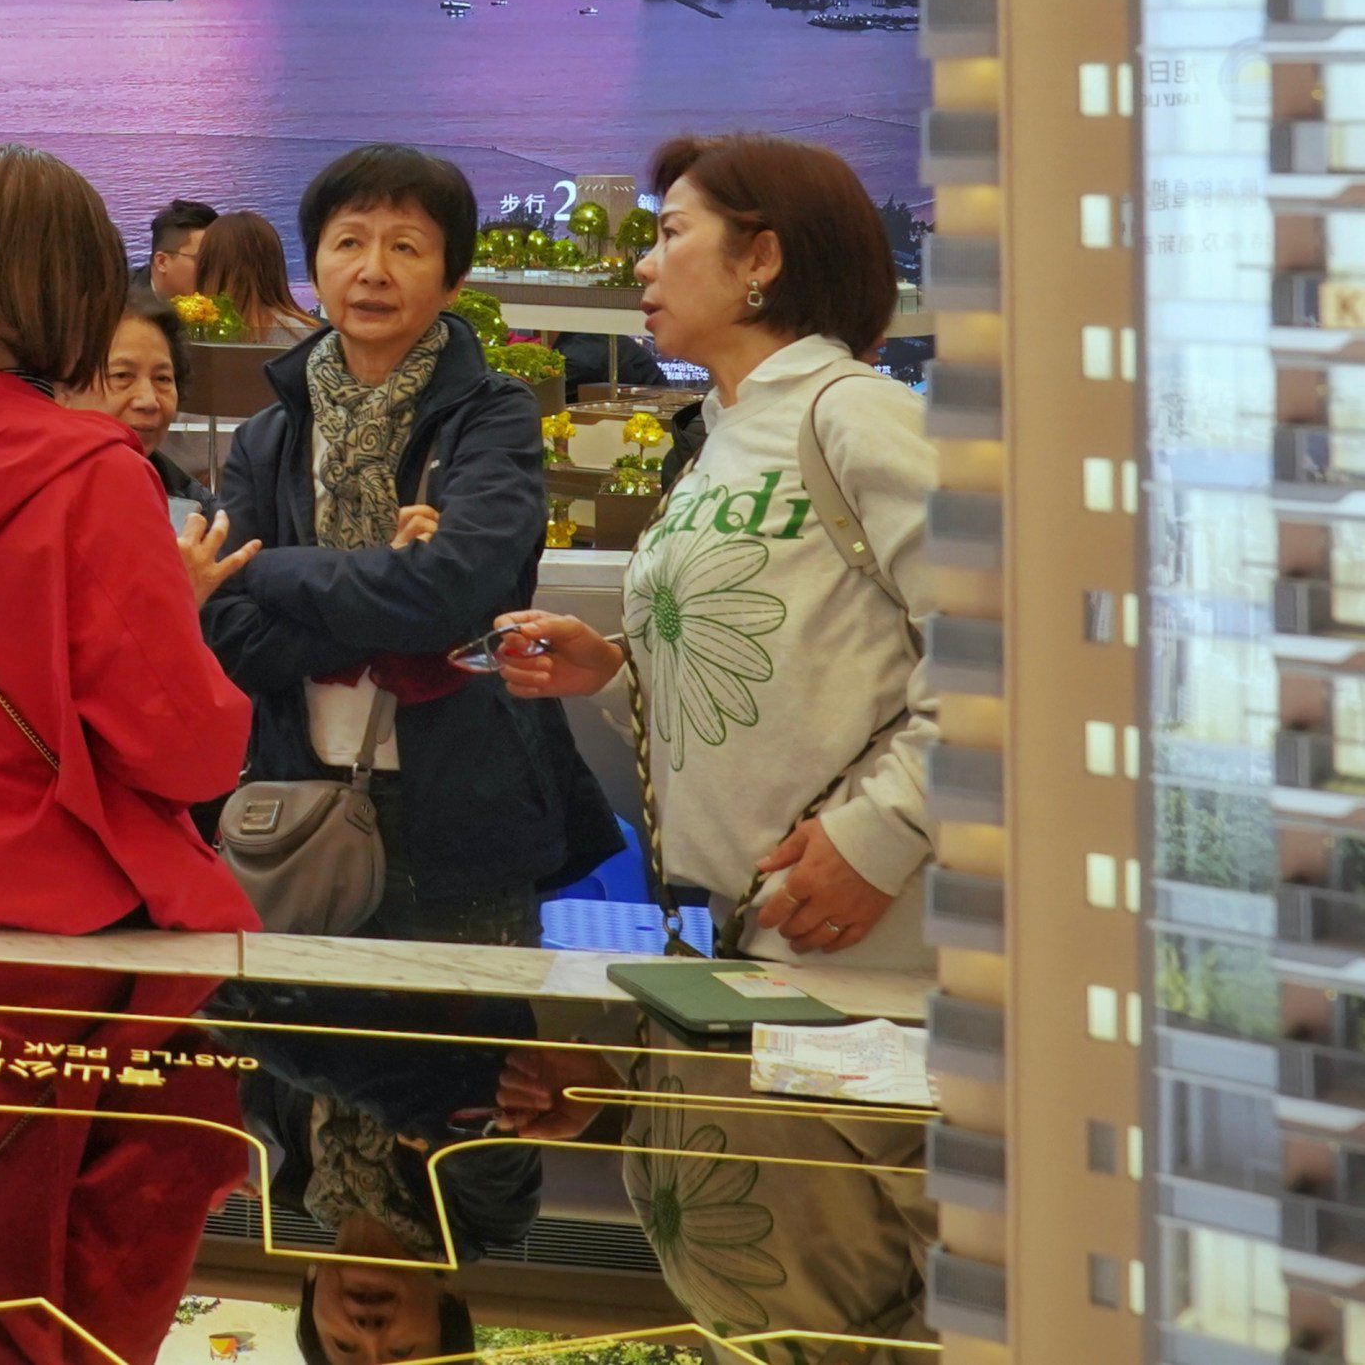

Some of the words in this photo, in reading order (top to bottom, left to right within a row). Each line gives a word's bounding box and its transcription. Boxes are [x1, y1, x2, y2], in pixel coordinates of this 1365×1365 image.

[500, 194, 546, 214] 步行
[553, 180, 577, 221] 2
[1335, 289, 1363, 324] K
[24, 1040, 109, 1060] PEAK
[130, 1048, 259, 1071] CASTLE
